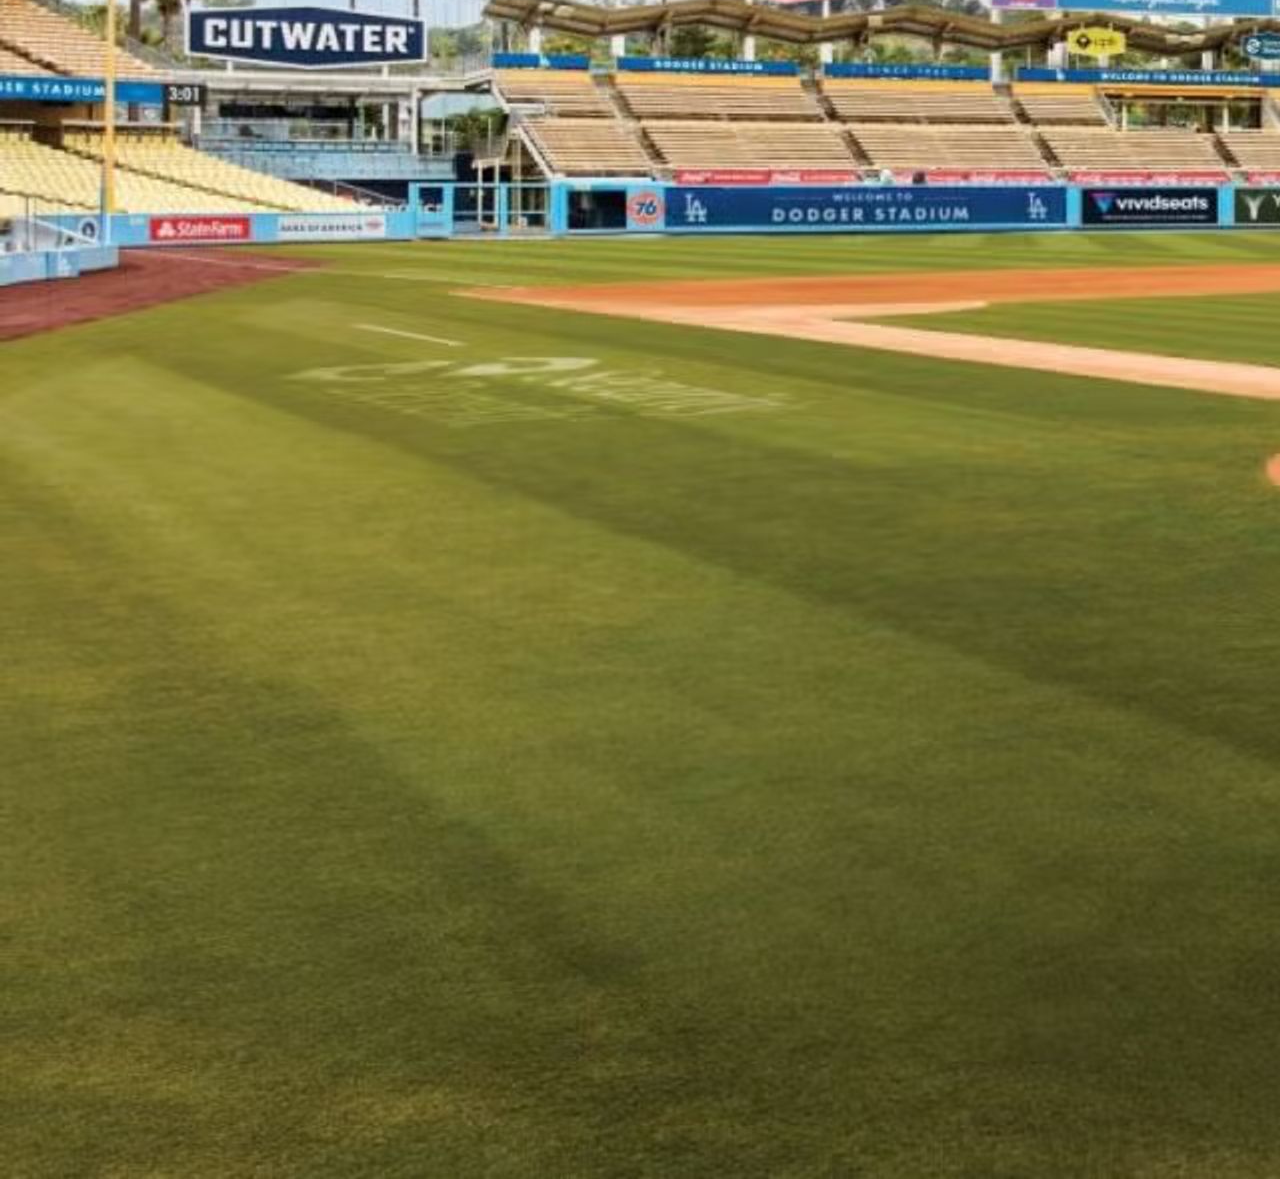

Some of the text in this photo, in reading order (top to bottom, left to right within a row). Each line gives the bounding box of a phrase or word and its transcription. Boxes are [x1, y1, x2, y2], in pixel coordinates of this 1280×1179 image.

[203, 17, 409, 53] CUTWATER
[32, 80, 105, 97] STADIUM
[168, 86, 200, 101] 3:01
[832, 192, 914, 202] WELCOME TO
[1026, 192, 1048, 218] LA
[1115, 195, 1209, 211] vividseats
[633, 200, 657, 217] 76
[685, 193, 707, 223] LA
[772, 206, 970, 222] DODGER STADIUM
